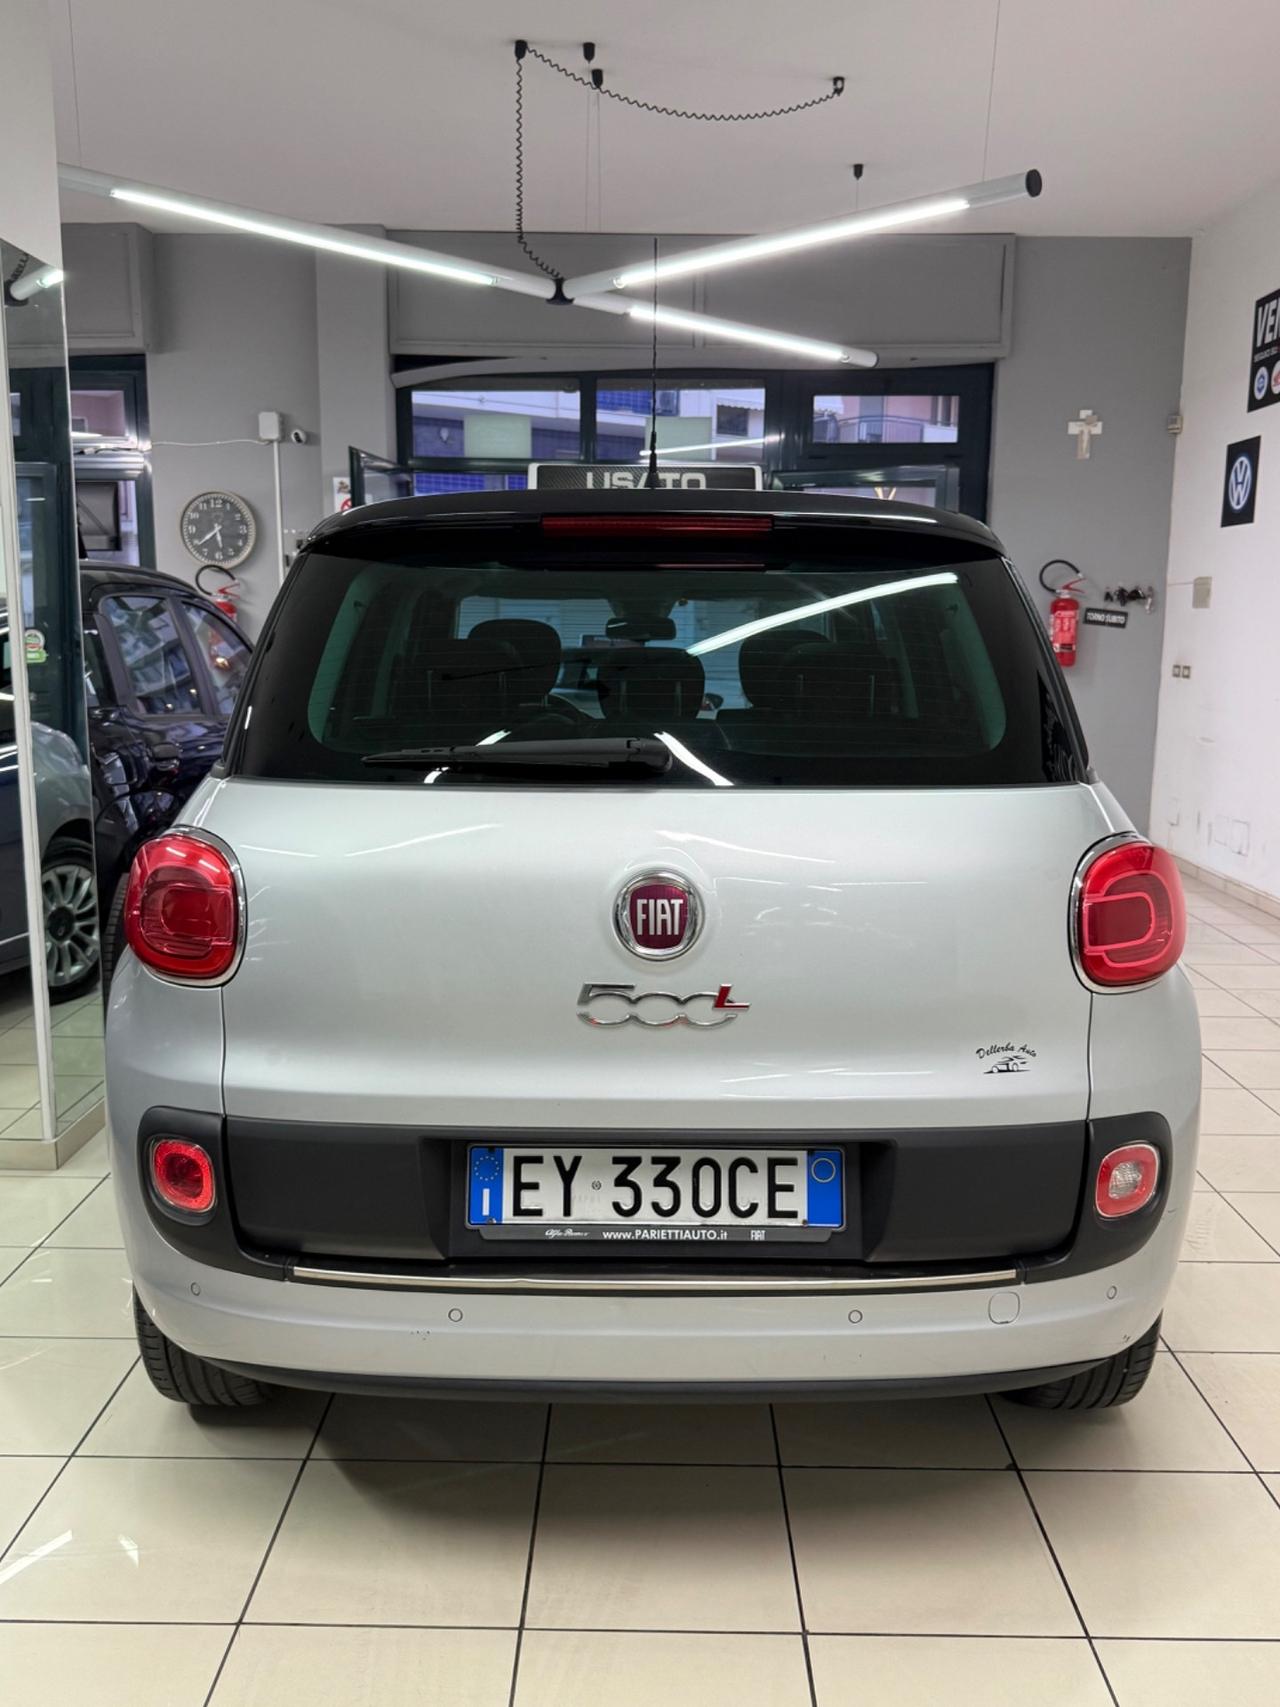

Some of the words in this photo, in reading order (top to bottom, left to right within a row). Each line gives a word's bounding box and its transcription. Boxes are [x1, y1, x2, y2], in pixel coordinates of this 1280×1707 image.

[210, 498, 224, 508] 12
[188, 525, 196, 534] 9
[239, 524, 247, 535] 3
[214, 550, 224, 560] 6
[636, 898, 684, 936] FIAT
[512, 1154, 583, 1218] EY
[611, 1155, 799, 1219] 330CE
[602, 1229, 728, 1241] www.PARIETTIAUTO.it
